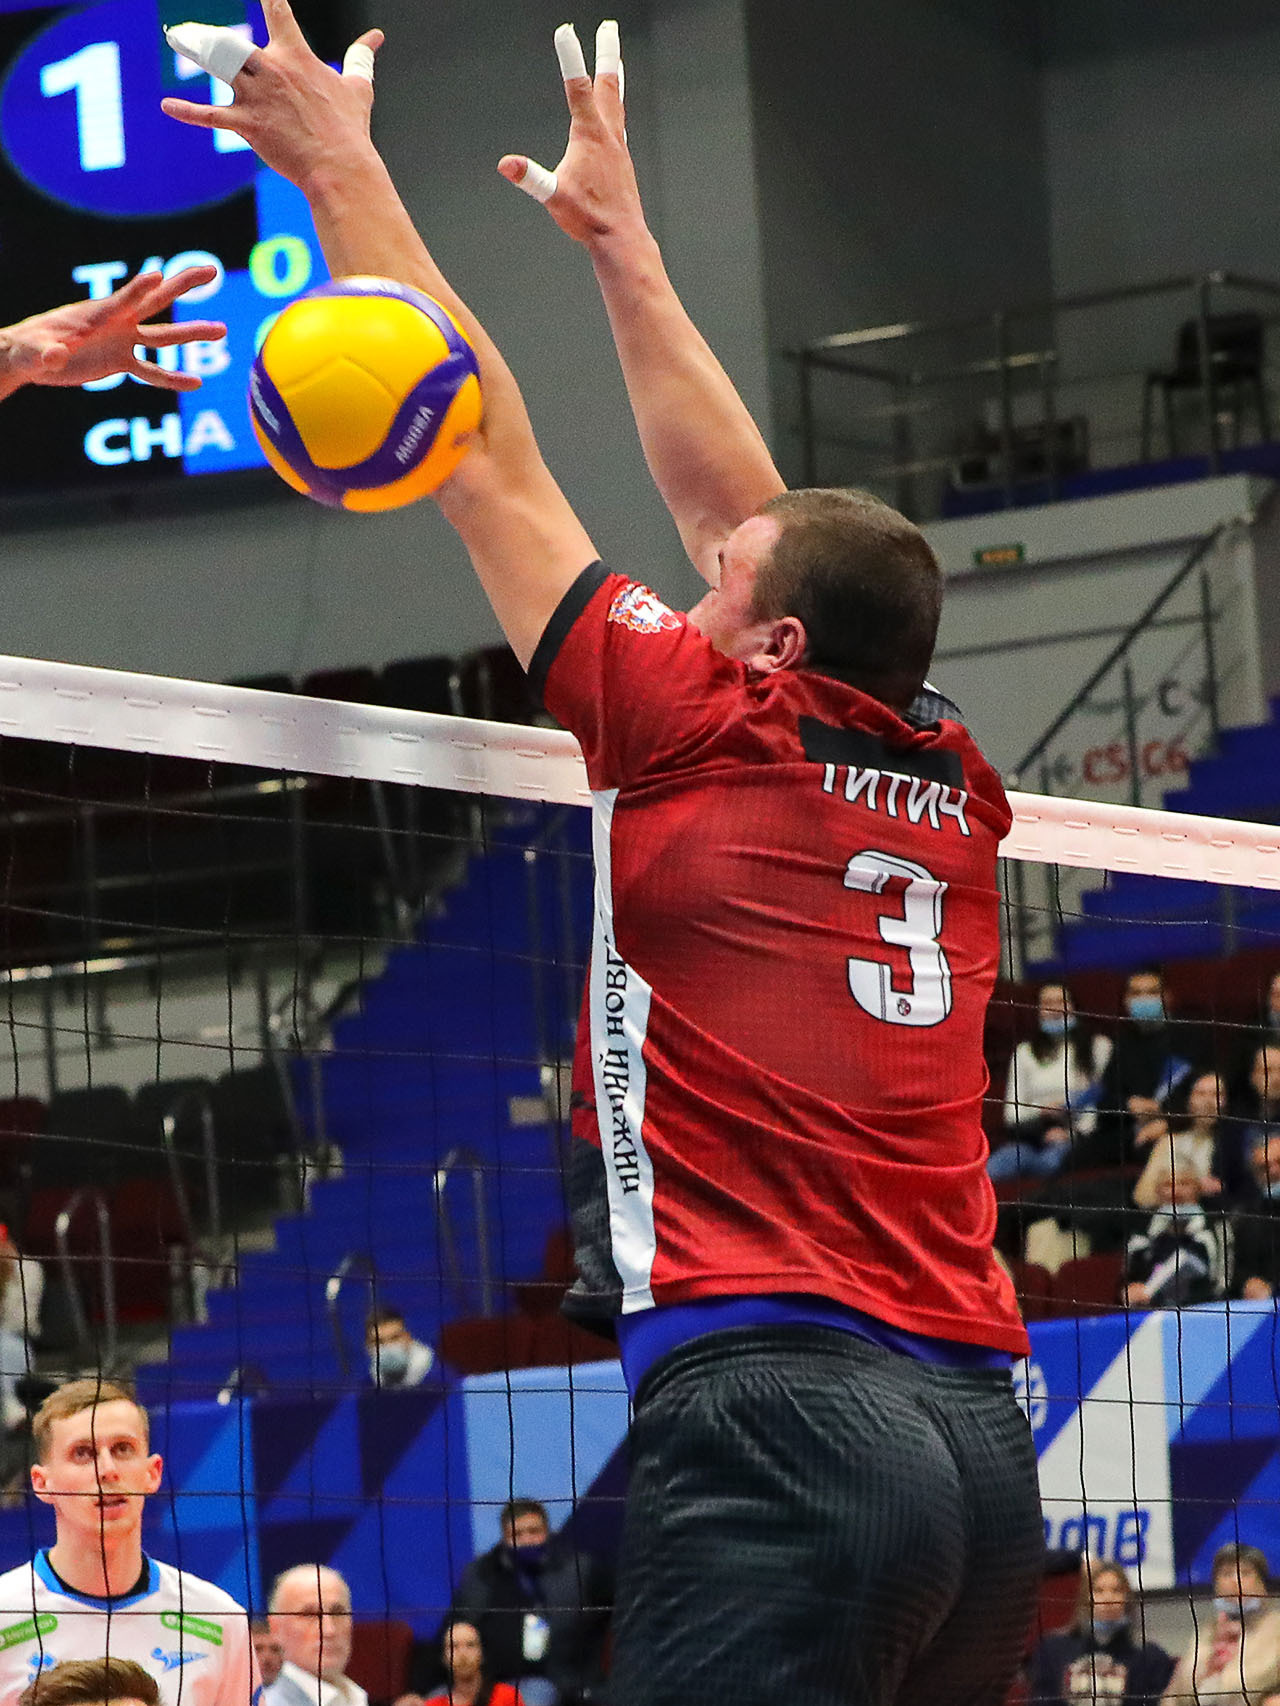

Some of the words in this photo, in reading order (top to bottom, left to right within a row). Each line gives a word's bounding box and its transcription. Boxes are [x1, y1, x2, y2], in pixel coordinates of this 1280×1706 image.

[248, 234, 312, 298] 0
[84, 409, 235, 466] CHA
[843, 850, 953, 1027] 3
[606, 950, 628, 1037] НОВГ
